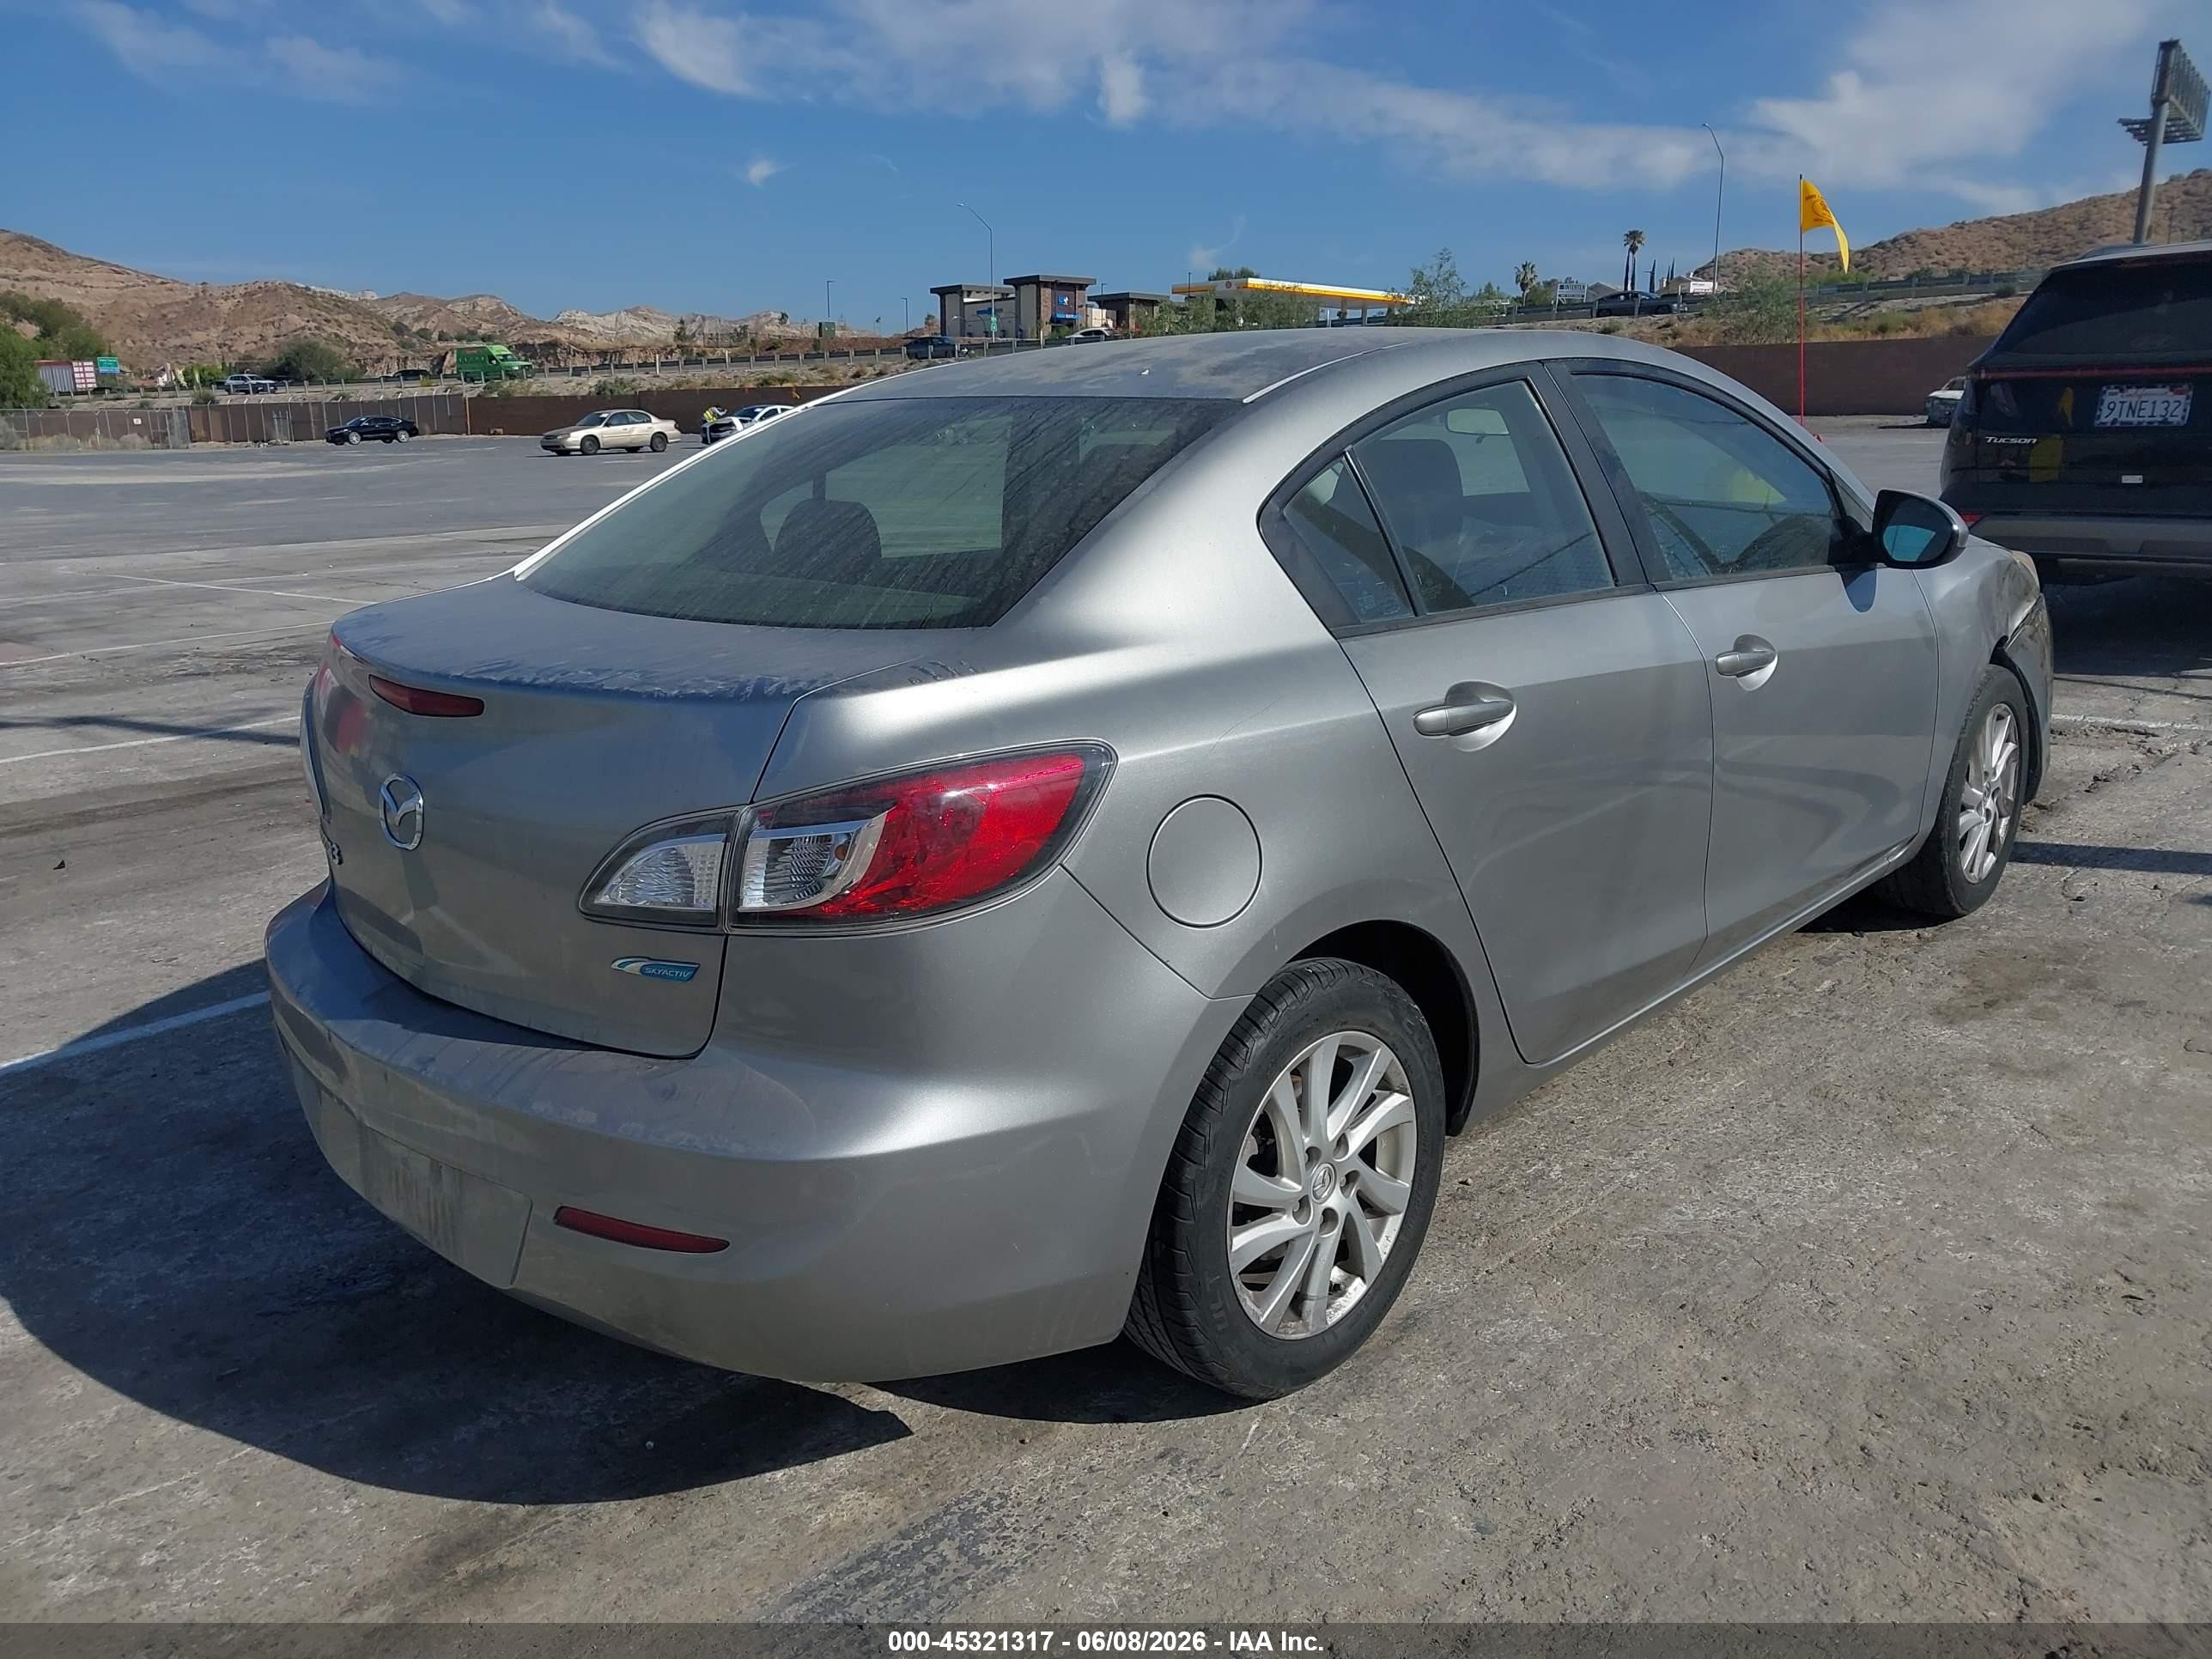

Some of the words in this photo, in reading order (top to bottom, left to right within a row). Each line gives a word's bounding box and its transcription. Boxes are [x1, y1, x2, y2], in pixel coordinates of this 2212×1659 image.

[2104, 399, 2182, 419] 9TNE132
[1984, 435, 2039, 445] Tucson
[644, 966, 692, 978] SKYACTIV
